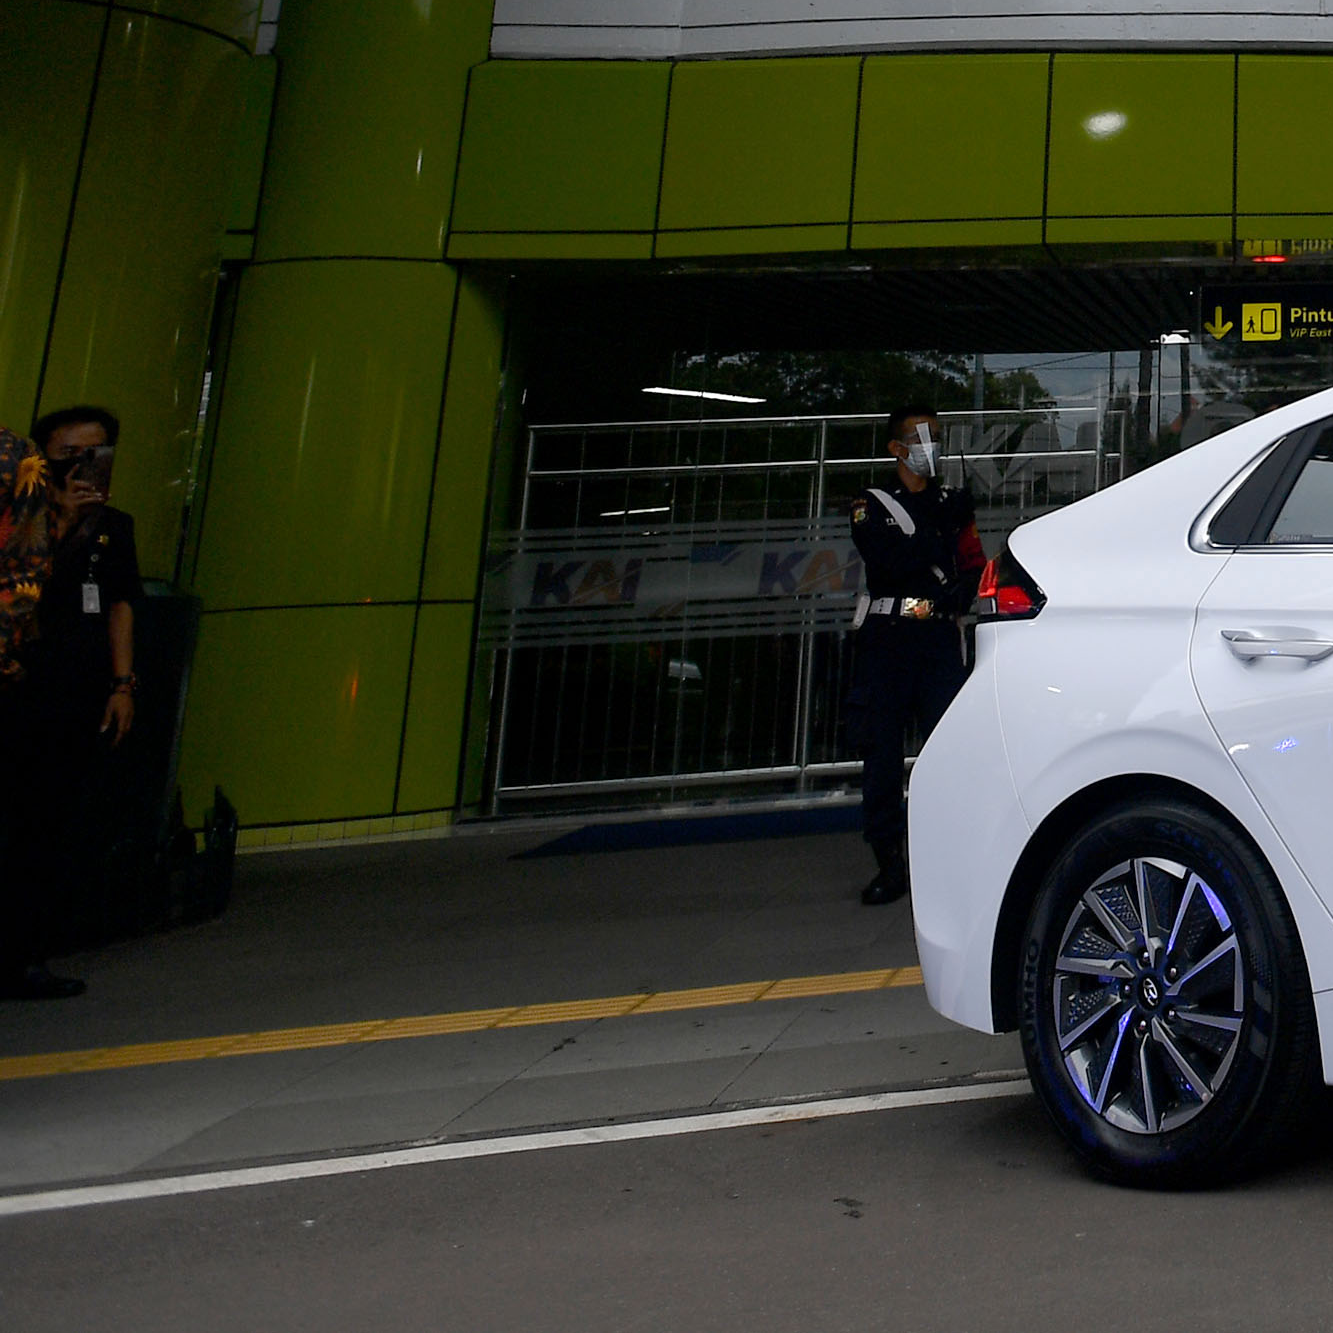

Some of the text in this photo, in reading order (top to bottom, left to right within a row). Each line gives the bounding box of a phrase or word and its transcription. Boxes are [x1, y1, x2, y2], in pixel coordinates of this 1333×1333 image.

[1289, 328, 1308, 338] VIP
[1309, 328, 1332, 338] East
[531, 559, 643, 606] KAI
